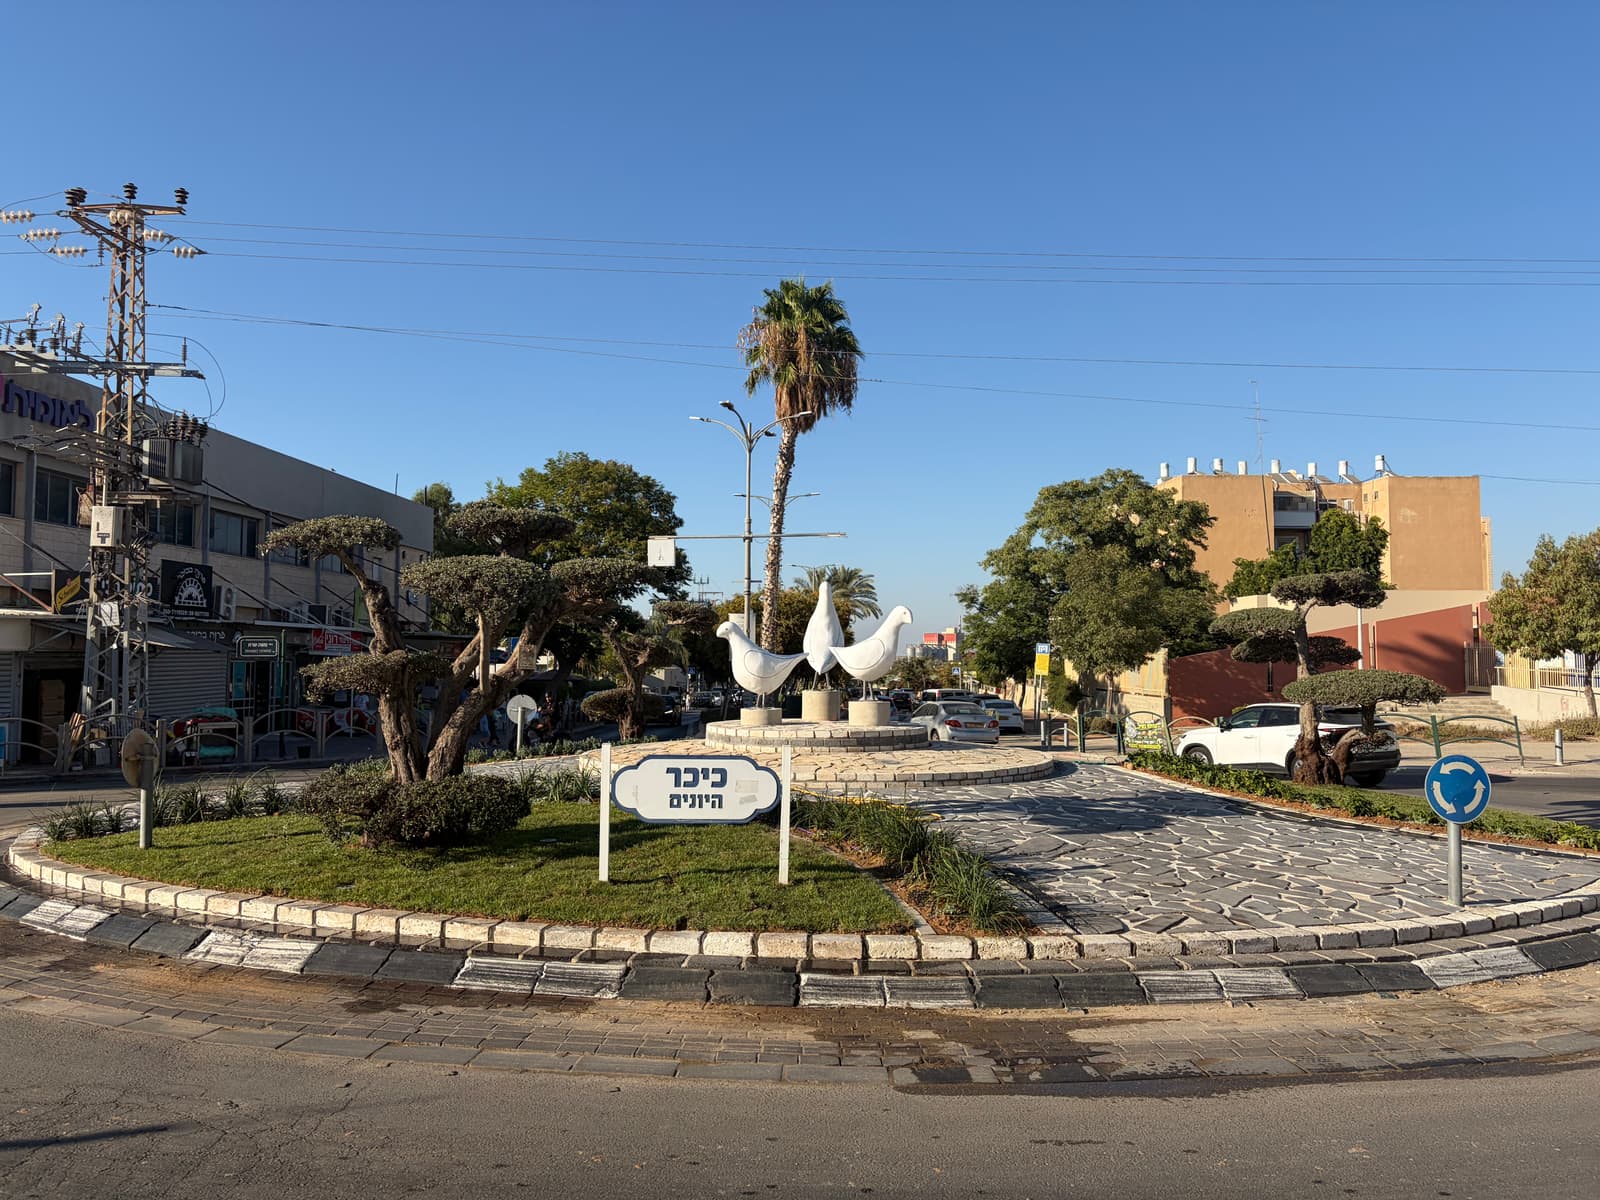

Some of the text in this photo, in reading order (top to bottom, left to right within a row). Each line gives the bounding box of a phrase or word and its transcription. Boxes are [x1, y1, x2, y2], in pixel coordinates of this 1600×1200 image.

[3, 380, 95, 432] לאומית
[666, 767, 728, 788] כיכר
[669, 794, 723, 809] היונים
